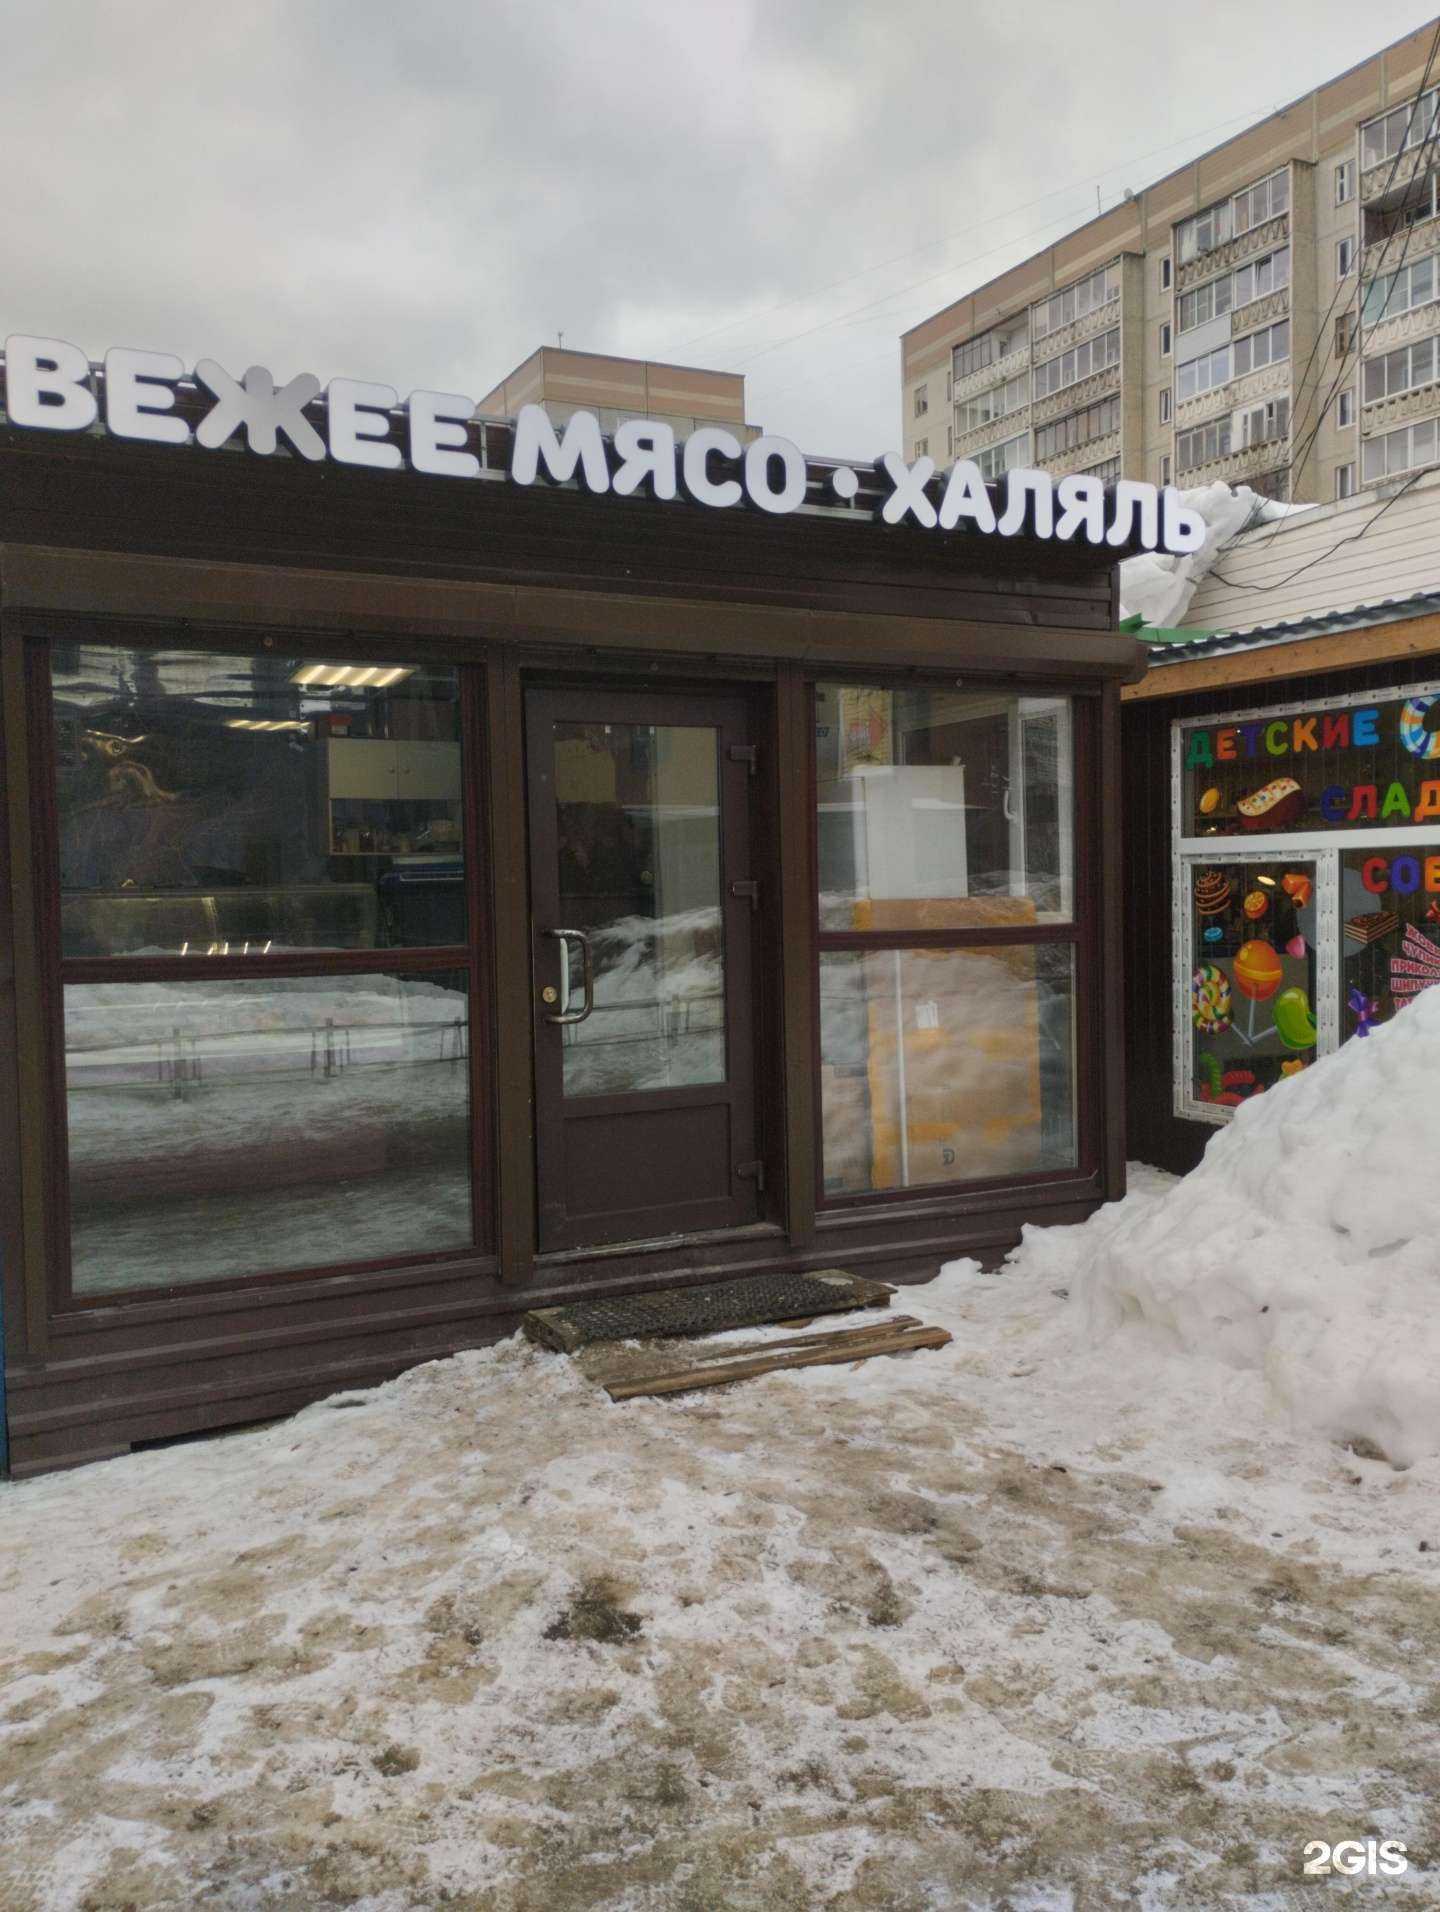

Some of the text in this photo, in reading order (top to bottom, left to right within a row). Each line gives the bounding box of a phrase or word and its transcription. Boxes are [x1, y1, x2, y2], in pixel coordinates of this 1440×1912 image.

[4, 335, 1206, 553] ВЕЖЕЕ МЯСО ХАЛЯЛЬ
[1185, 709, 1380, 769] ДЕТСКИЕ
